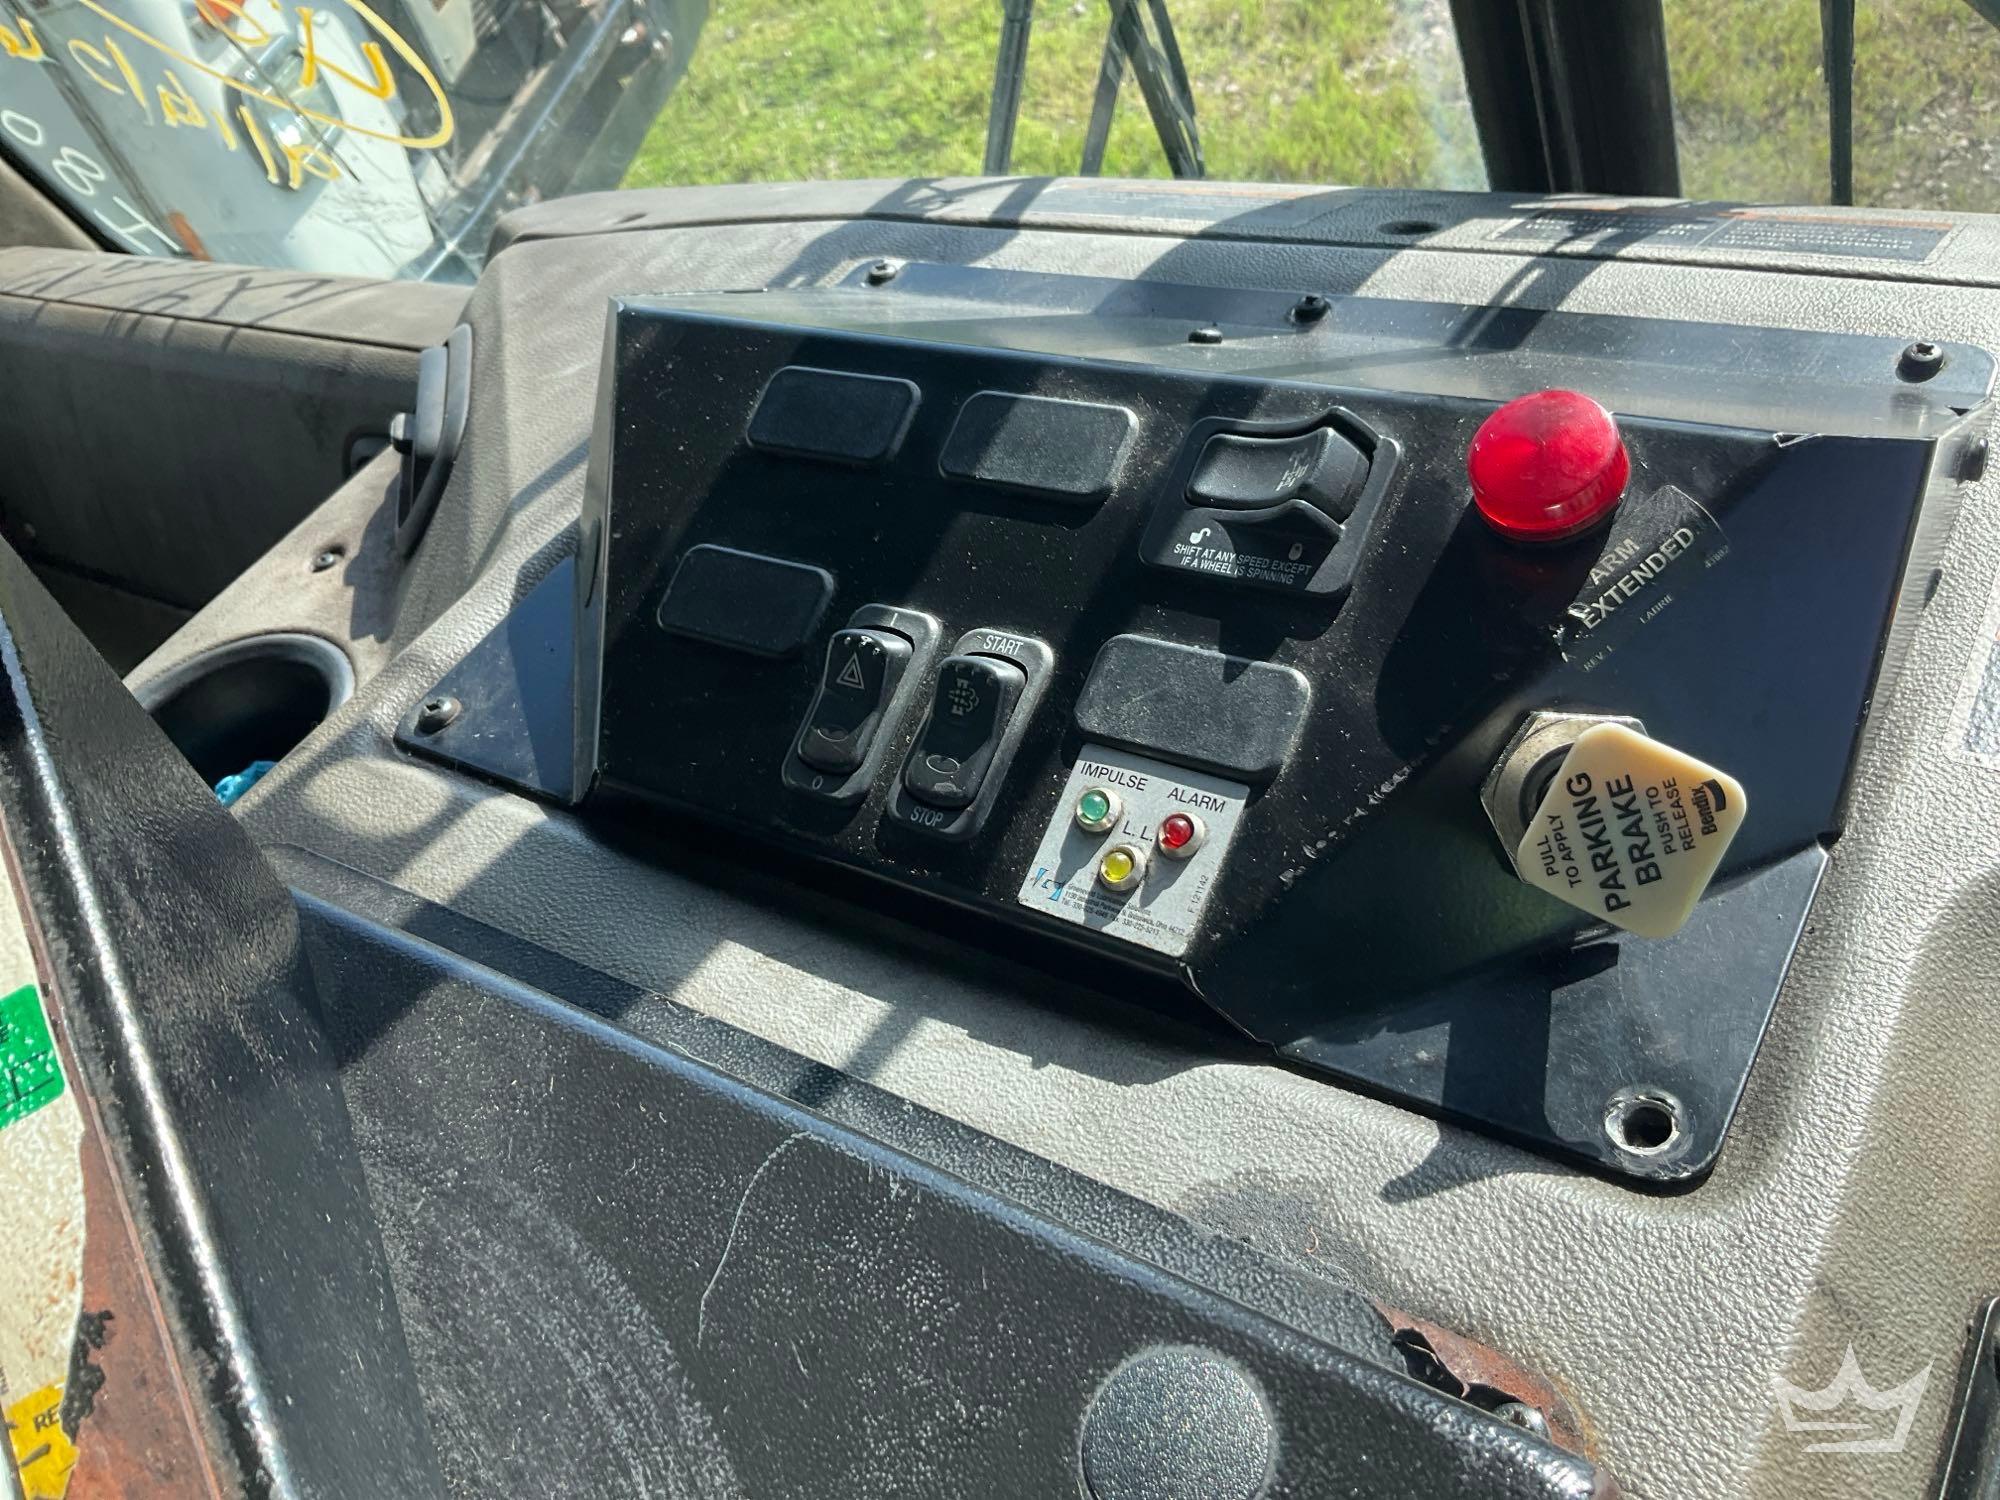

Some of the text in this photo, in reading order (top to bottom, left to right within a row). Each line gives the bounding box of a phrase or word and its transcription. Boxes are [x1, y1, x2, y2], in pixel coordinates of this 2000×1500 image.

[1173, 543, 1312, 577] SHIFT AT ANY SPEED EXCEPT
[1181, 556, 1295, 585] IF A WHEEL IS SPINNING
[1583, 527, 1696, 629] EXTENDED
[1590, 538, 1641, 586] ARM
[983, 634, 1025, 655] START
[1080, 761, 1149, 792] IMPULSE
[1167, 787, 1226, 814] ALARM
[910, 806, 945, 827] STOP
[1606, 773, 1663, 887] BRAKE
[1645, 786, 1678, 856] PUSH TO
[1662, 776, 1696, 852] RELEASE
[1690, 785, 1719, 836] Bendix
[1537, 834, 1559, 877] PULL
[1546, 814, 1583, 889] TO APPLY
[1566, 771, 1631, 913] PARKING
